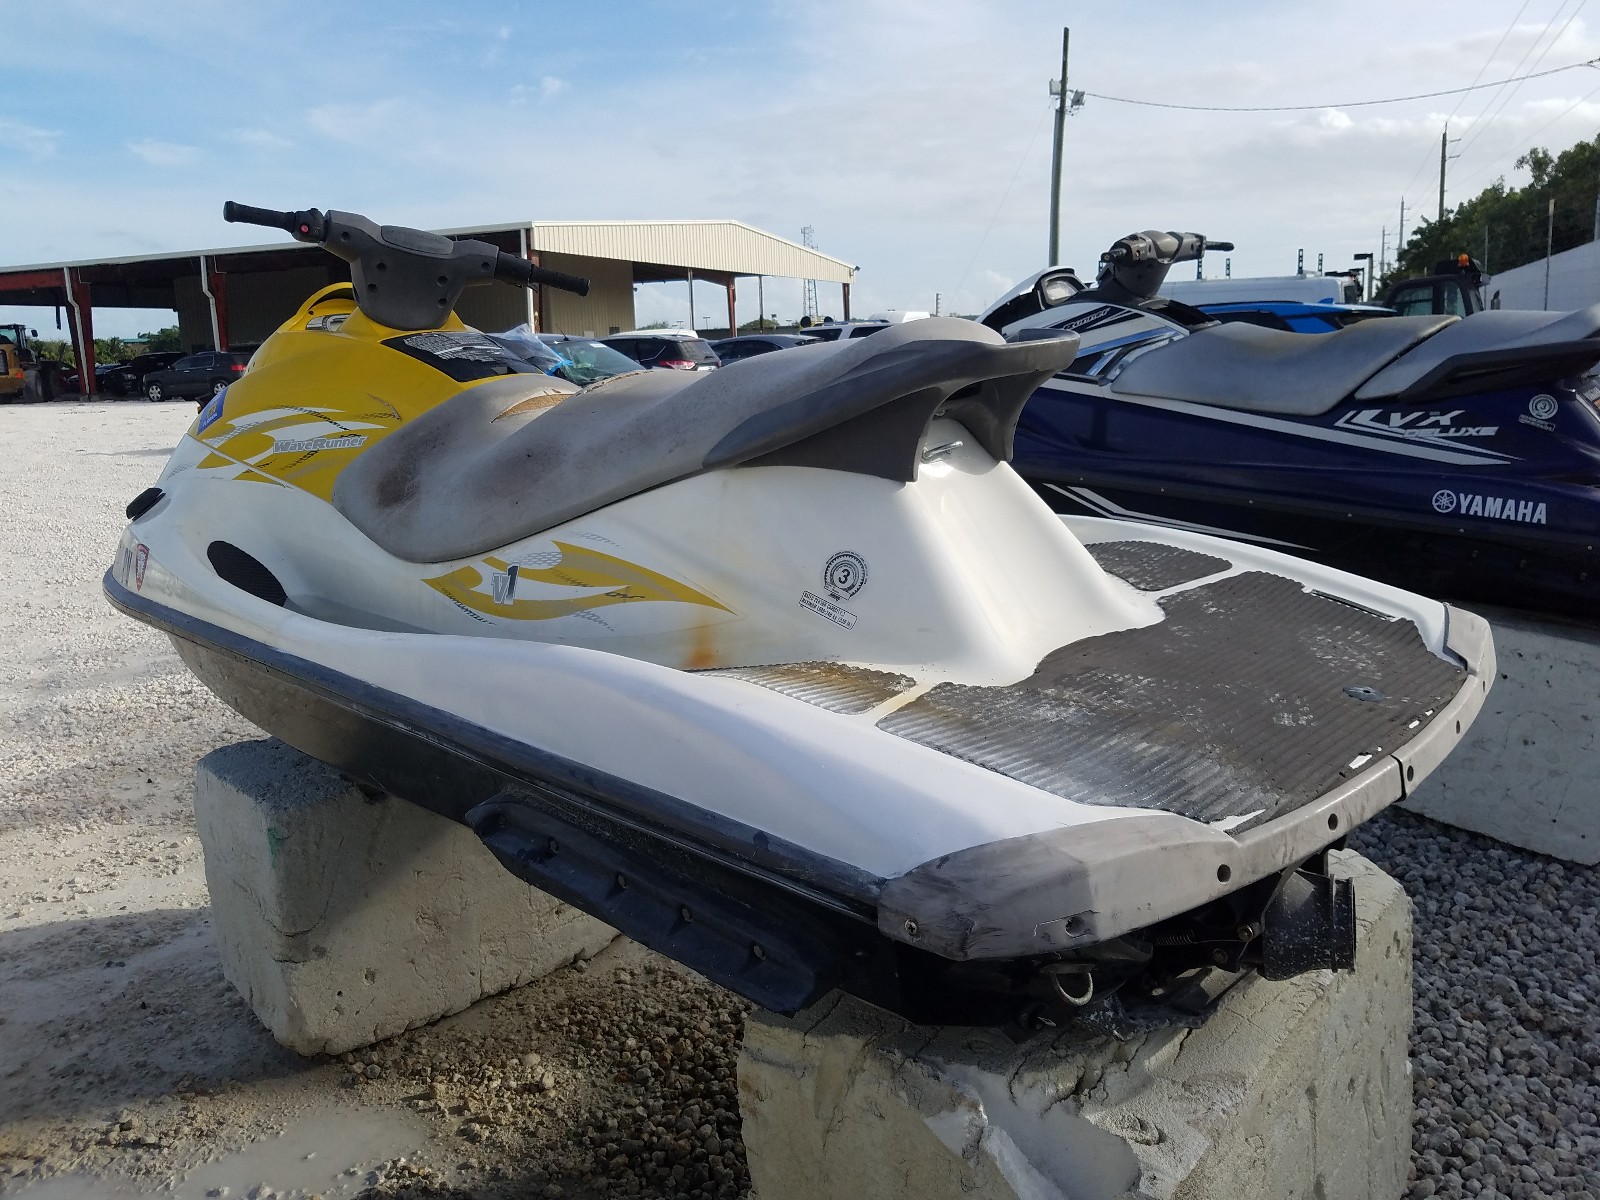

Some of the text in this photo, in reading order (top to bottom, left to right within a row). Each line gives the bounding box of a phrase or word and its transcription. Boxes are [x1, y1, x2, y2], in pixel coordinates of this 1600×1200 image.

[1401, 426, 1499, 438] DELUXE
[273, 436, 368, 454] WaveRunner
[1459, 493, 1547, 525] YAMAHA
[838, 568, 851, 584] 3
